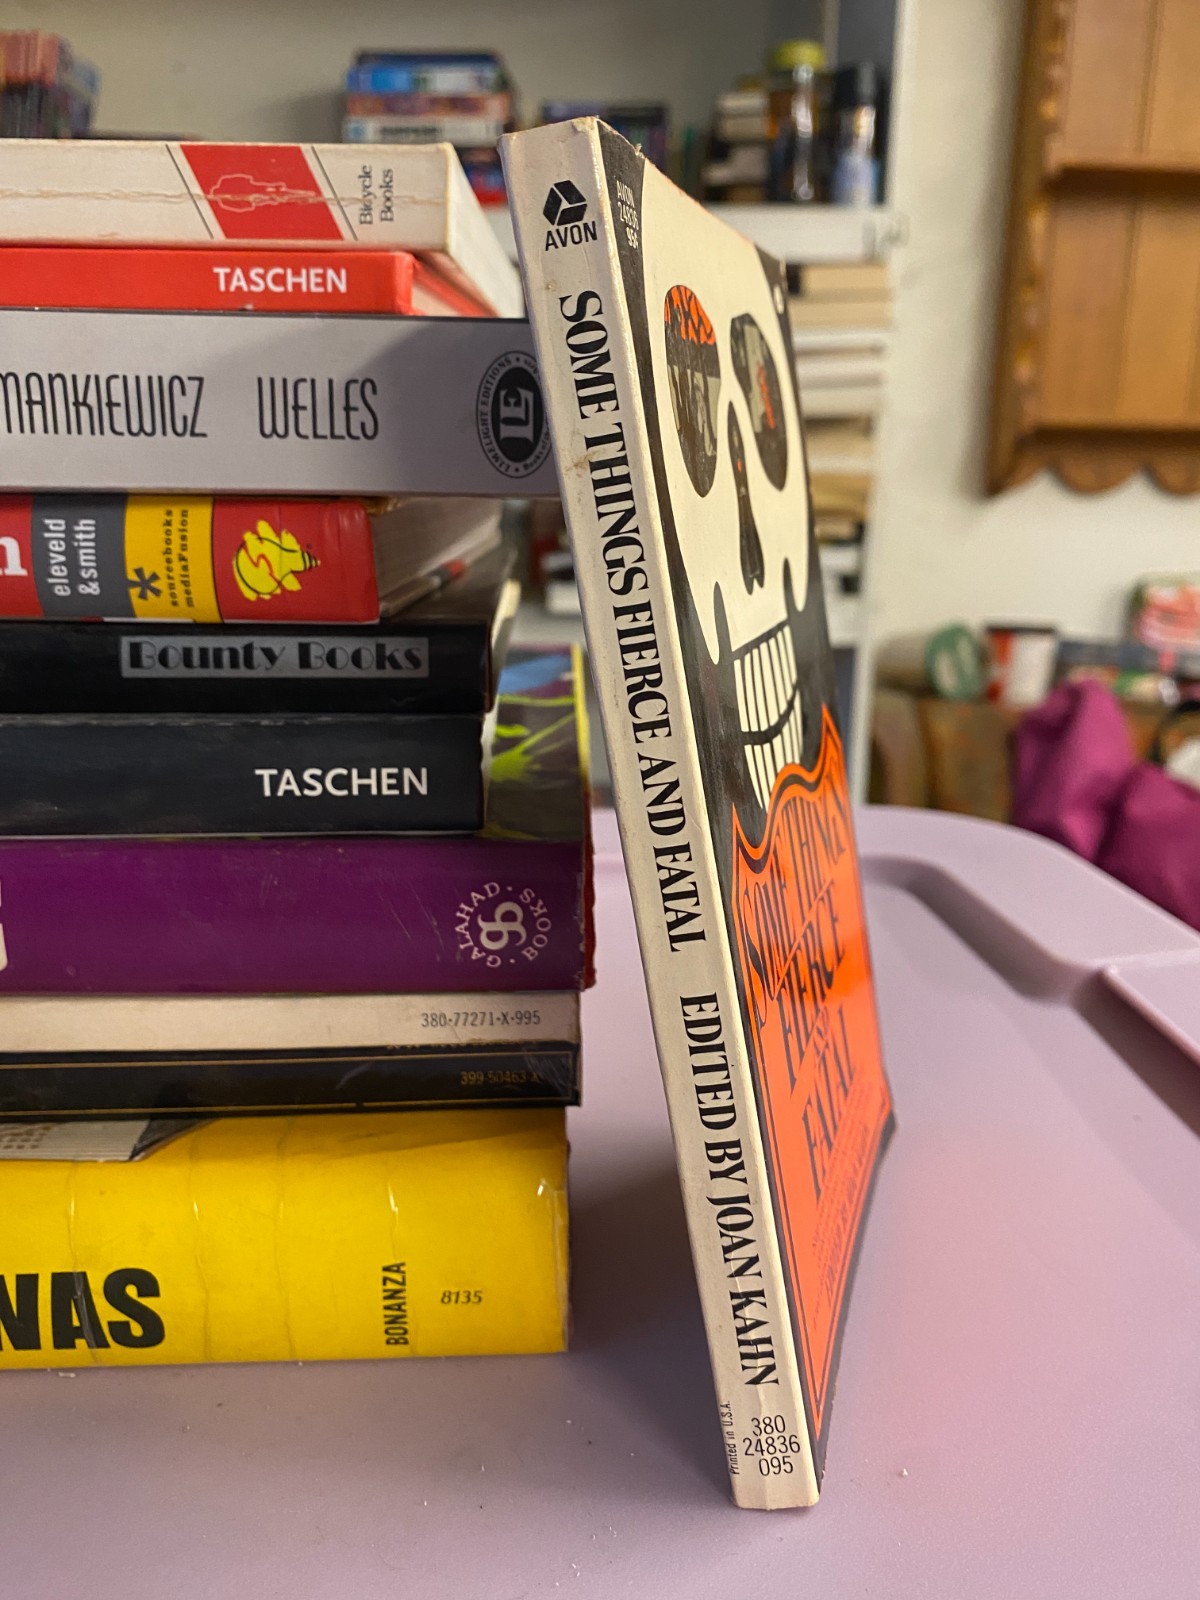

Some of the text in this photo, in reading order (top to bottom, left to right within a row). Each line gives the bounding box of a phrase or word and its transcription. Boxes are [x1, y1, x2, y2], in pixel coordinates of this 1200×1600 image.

[358, 165, 377, 224] Bicycle
[379, 168, 394, 222] Books
[616, 180, 635, 208] AVON
[545, 221, 597, 252] AVON
[213, 267, 347, 293] TASCHEN
[257, 377, 379, 440] WELLES
[43, 517, 71, 596] eleveld
[163, 508, 180, 608] sourcebooks
[179, 508, 195, 609] mediaFusion
[559, 290, 707, 952] SOME THINGS FIERCE AND FATAL
[128, 640, 422, 672] Bounty Books
[254, 766, 428, 797] TASCHEN
[454, 881, 552, 968] GALAHAD BOOKS
[680, 991, 780, 1387] EDITED BY JOAN KAHN
[382, 1262, 409, 1345] BONANZA
[440, 1289, 483, 1305] 8135
[725, 1430, 735, 1440] in
[751, 1414, 786, 1437] 380
[726, 1443, 740, 1475] Printed
[742, 1434, 800, 1456] 24836
[758, 1455, 794, 1476] 095
